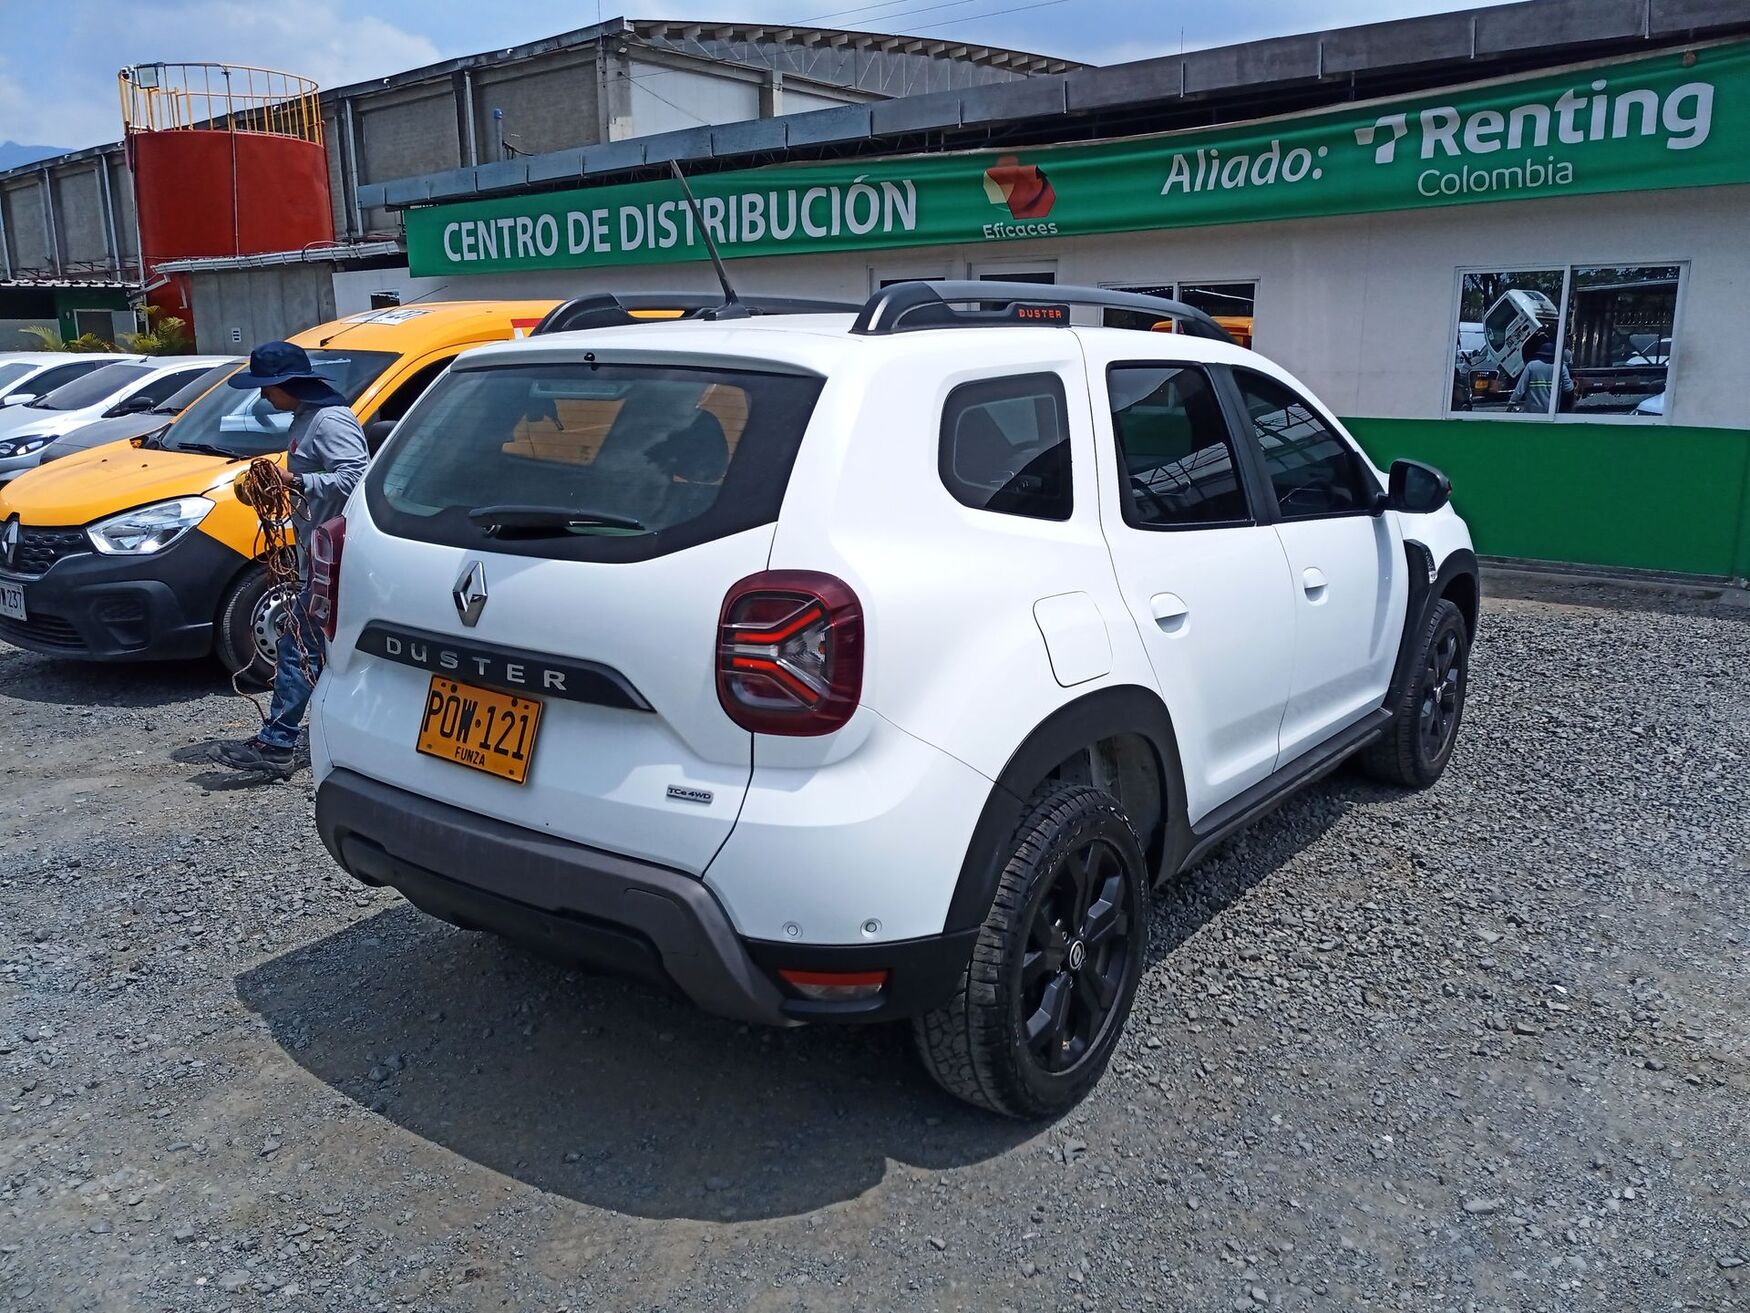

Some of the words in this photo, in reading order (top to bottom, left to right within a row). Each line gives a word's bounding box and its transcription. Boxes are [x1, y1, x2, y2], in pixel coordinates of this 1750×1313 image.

[1419, 79, 1715, 162] Renting
[1160, 139, 1329, 196] Aliado:
[1416, 156, 1574, 198] Colombia
[443, 213, 560, 262] CENTRO
[566, 208, 612, 255] DE
[619, 174, 917, 251] DISTRIBUCIÓN
[982, 221, 1059, 240] Eficaces
[1018, 307, 1063, 319] DUSTER
[385, 635, 569, 692] DUSTER
[454, 745, 487, 767] FUNZA
[687, 790, 712, 800] 4WD
